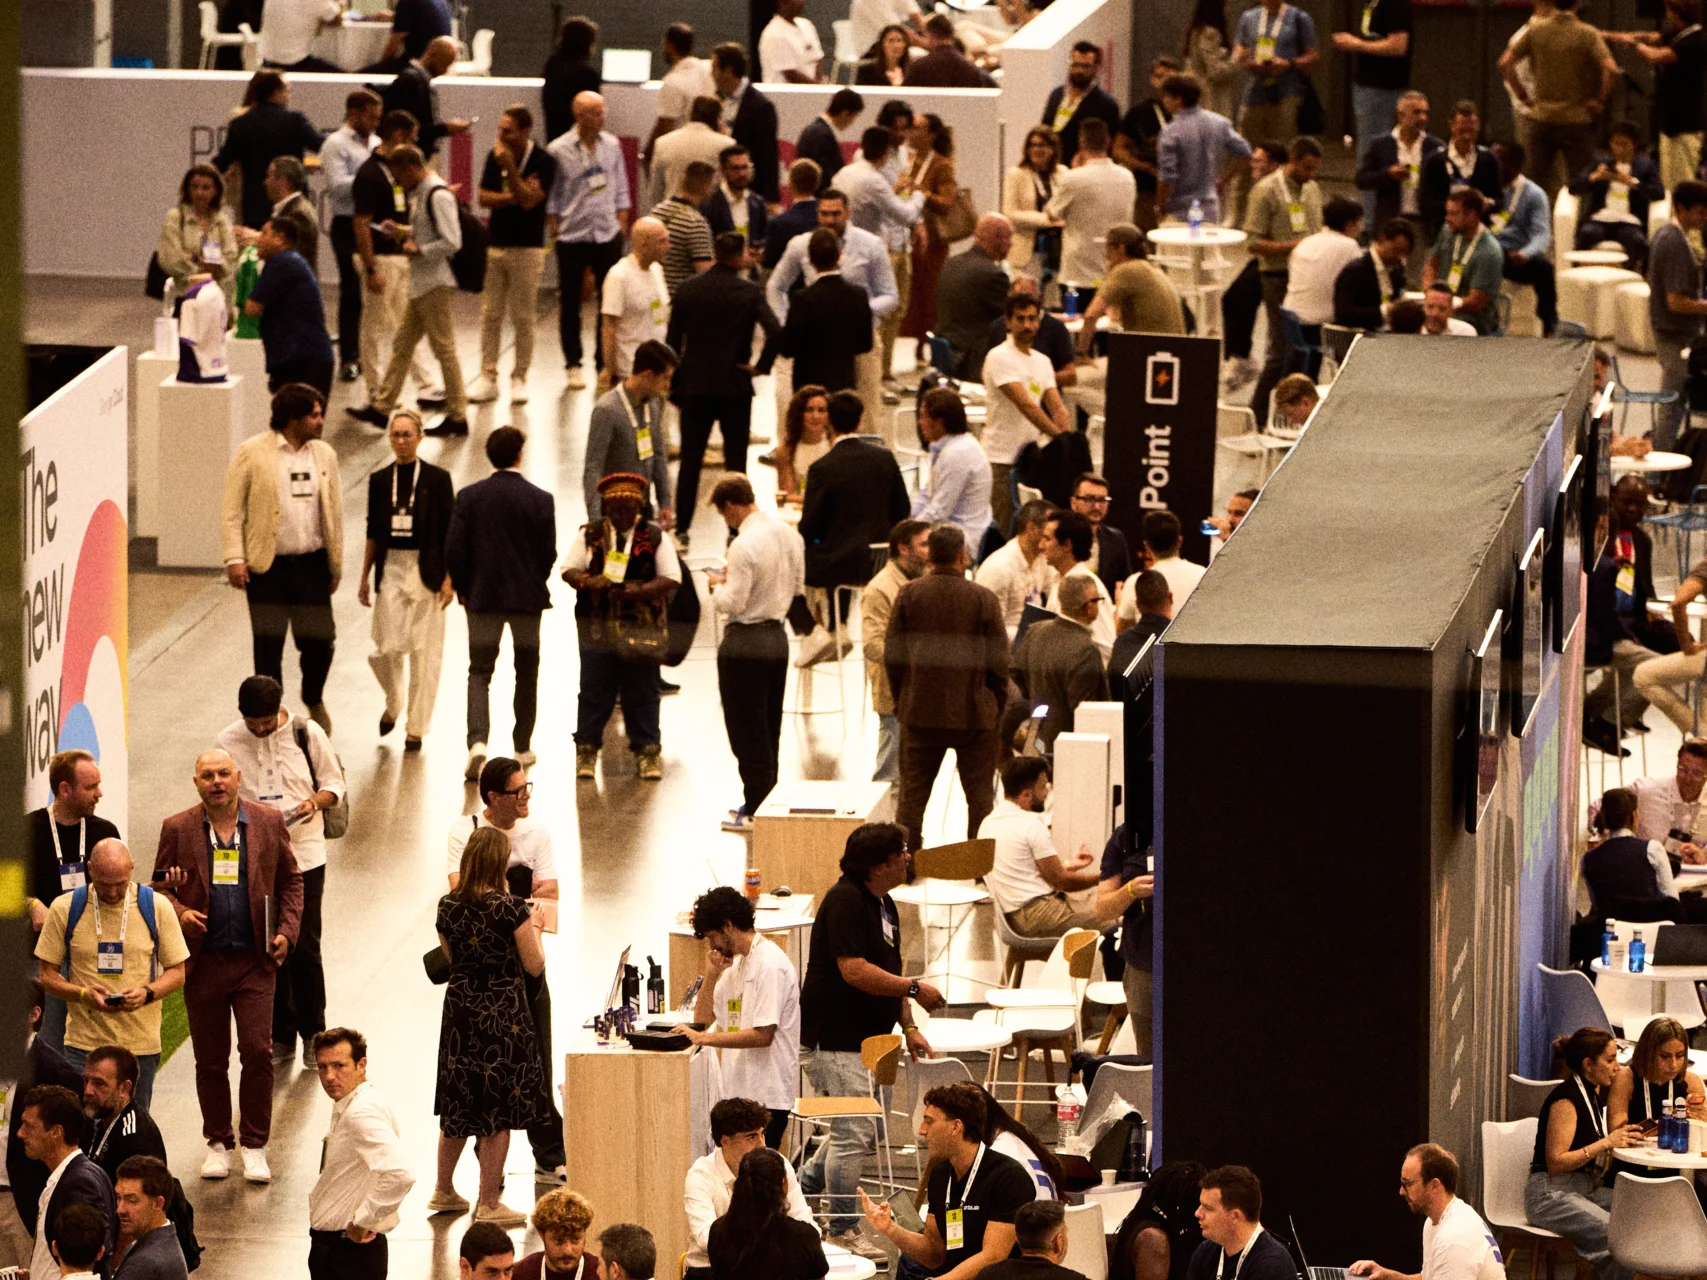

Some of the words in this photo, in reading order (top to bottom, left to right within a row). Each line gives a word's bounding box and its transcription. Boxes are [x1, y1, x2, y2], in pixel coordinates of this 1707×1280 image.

[20, 446, 58, 562] The
[1139, 424, 1172, 510] Point
[23, 563, 64, 668] new
